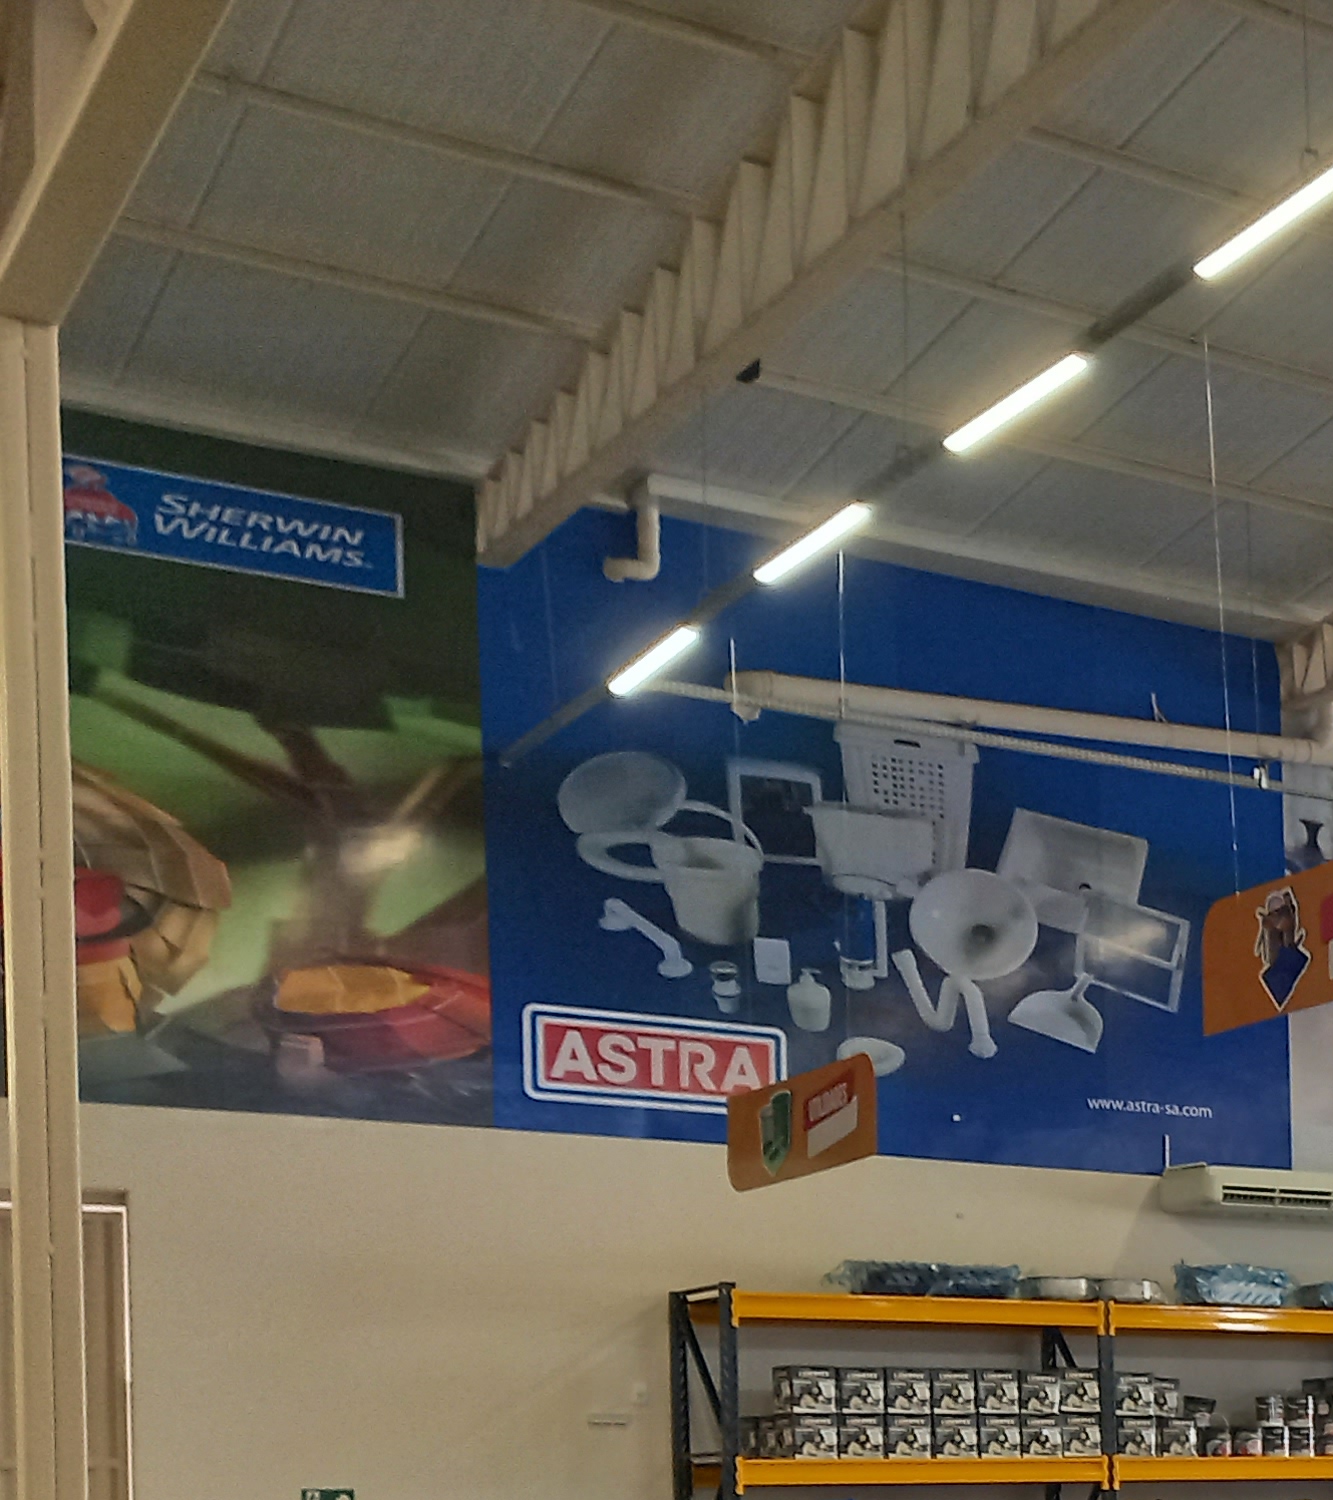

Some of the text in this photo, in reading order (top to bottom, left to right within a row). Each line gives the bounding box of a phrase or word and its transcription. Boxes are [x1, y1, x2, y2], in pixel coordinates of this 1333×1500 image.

[153, 512, 367, 569] WILLIAMS
[155, 492, 365, 547] SHERWIN
[549, 1028, 762, 1093] ASTRA
[1086, 1097, 1213, 1119] www.astra-sa.com
